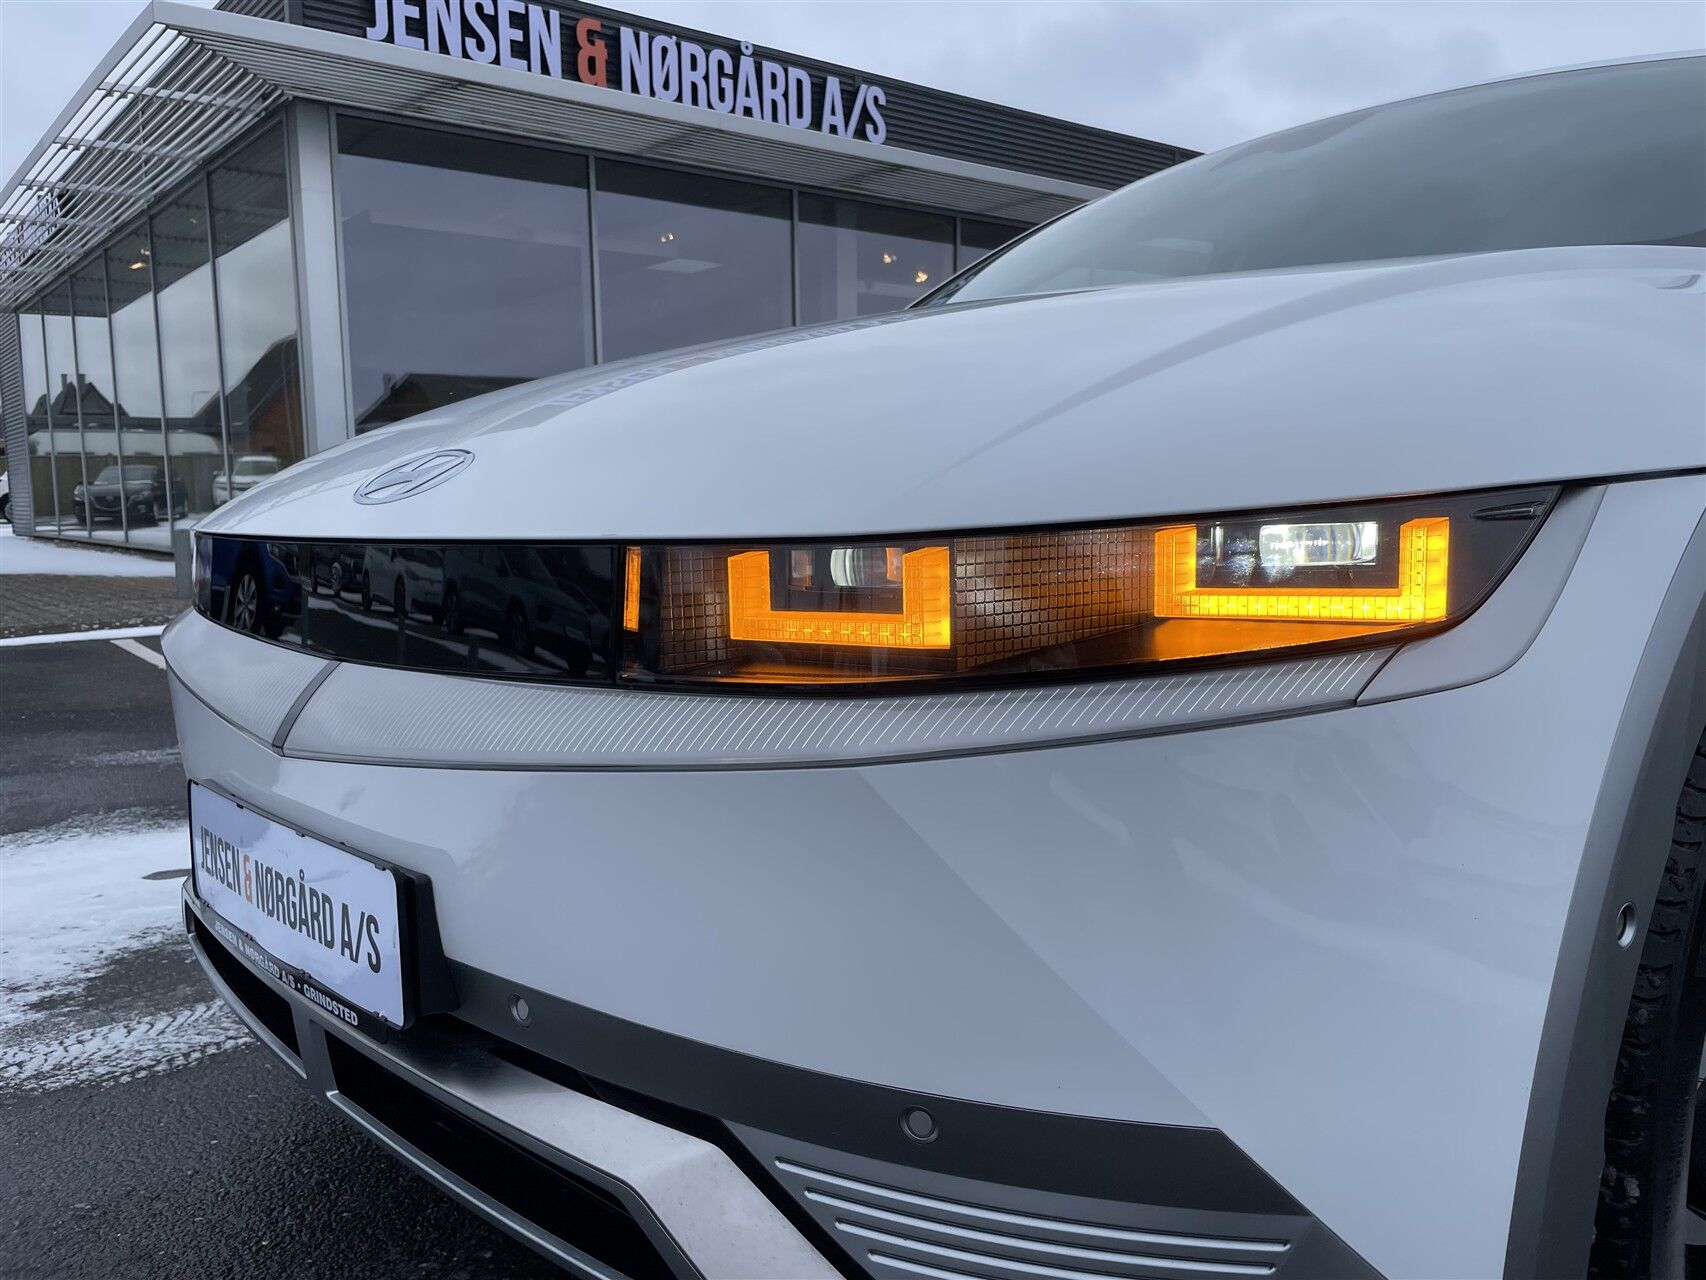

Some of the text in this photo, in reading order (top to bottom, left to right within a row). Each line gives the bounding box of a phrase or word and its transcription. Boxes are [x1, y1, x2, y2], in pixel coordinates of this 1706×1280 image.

[366, 0, 887, 145] JENSEN & NØRGÅRD A/S
[201, 825, 381, 973] JENSEN & NØRGÅRD A/S
[281, 970, 296, 989] A/S
[303, 983, 359, 1026] GRINDSTED
